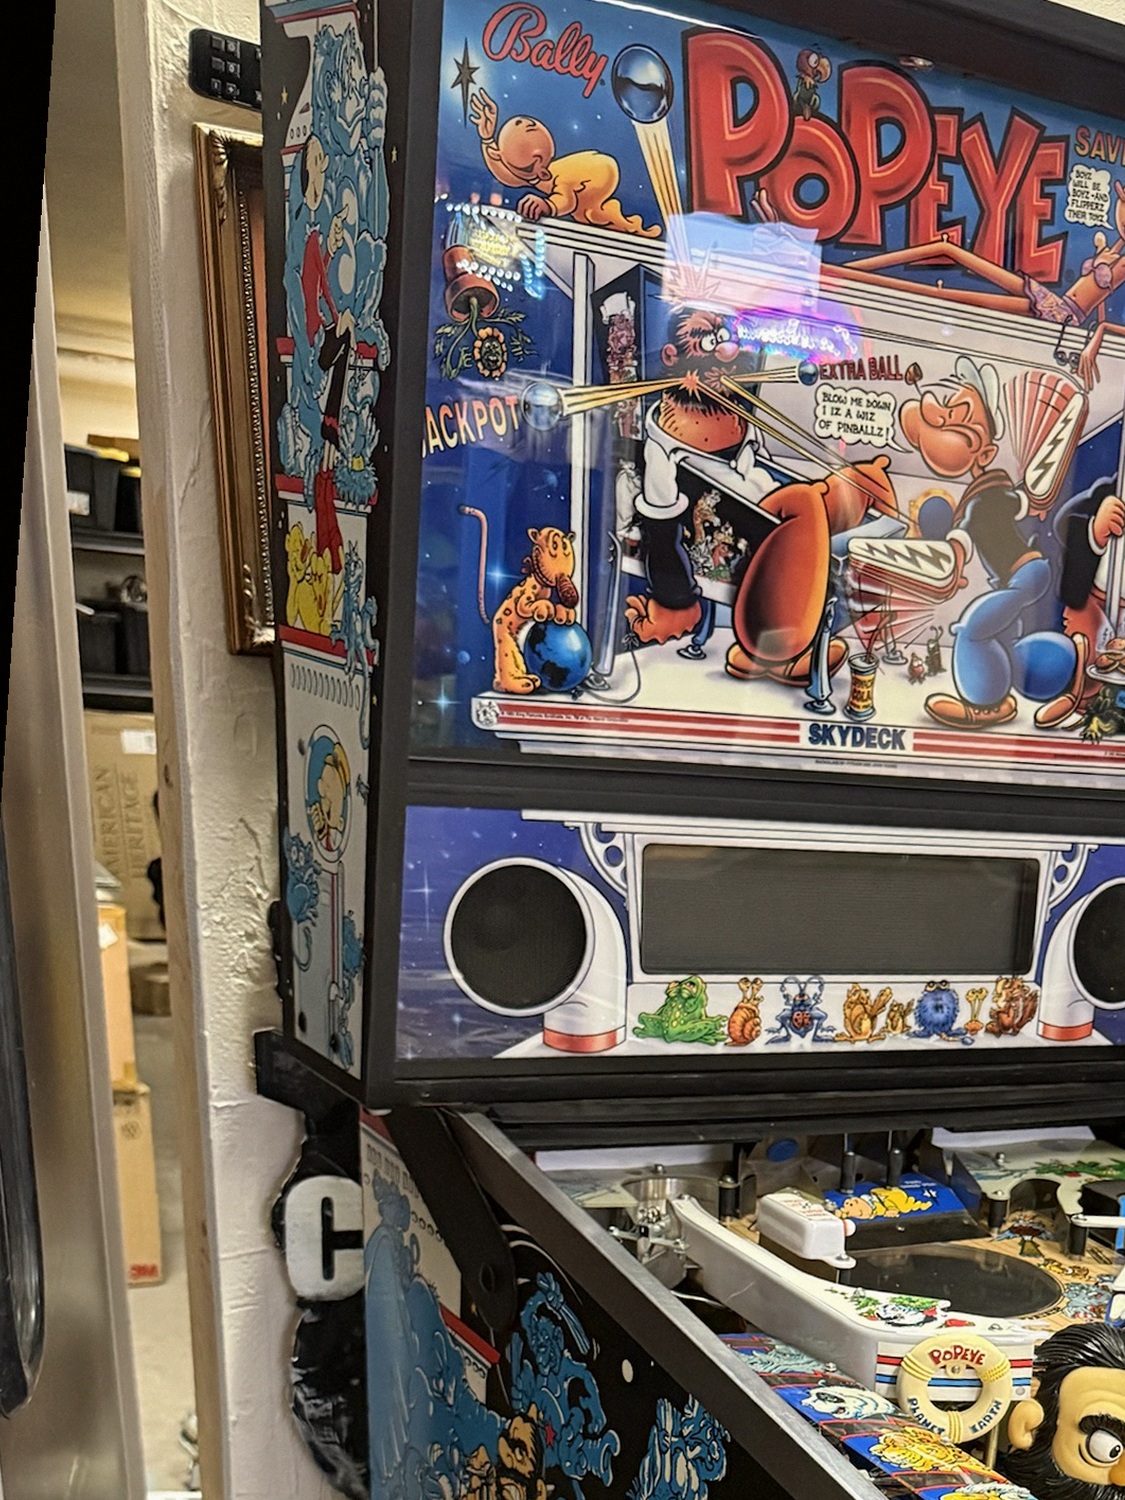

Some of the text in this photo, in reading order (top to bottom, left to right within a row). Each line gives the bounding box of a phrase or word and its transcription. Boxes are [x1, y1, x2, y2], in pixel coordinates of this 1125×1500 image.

[483, 3, 607, 97] Bally
[683, 24, 1069, 284] POPEYE
[820, 354, 903, 381] EXTRA BALL
[822, 392, 891, 412] BLOW ME DOWN
[845, 408, 852, 419] A
[856, 410, 876, 422] WIZ
[818, 419, 832, 430] OF
[808, 723, 907, 751] SKYDECK
[928, 1345, 985, 1366] POPEYE
[907, 1397, 1002, 1434] PLANET EARTH
